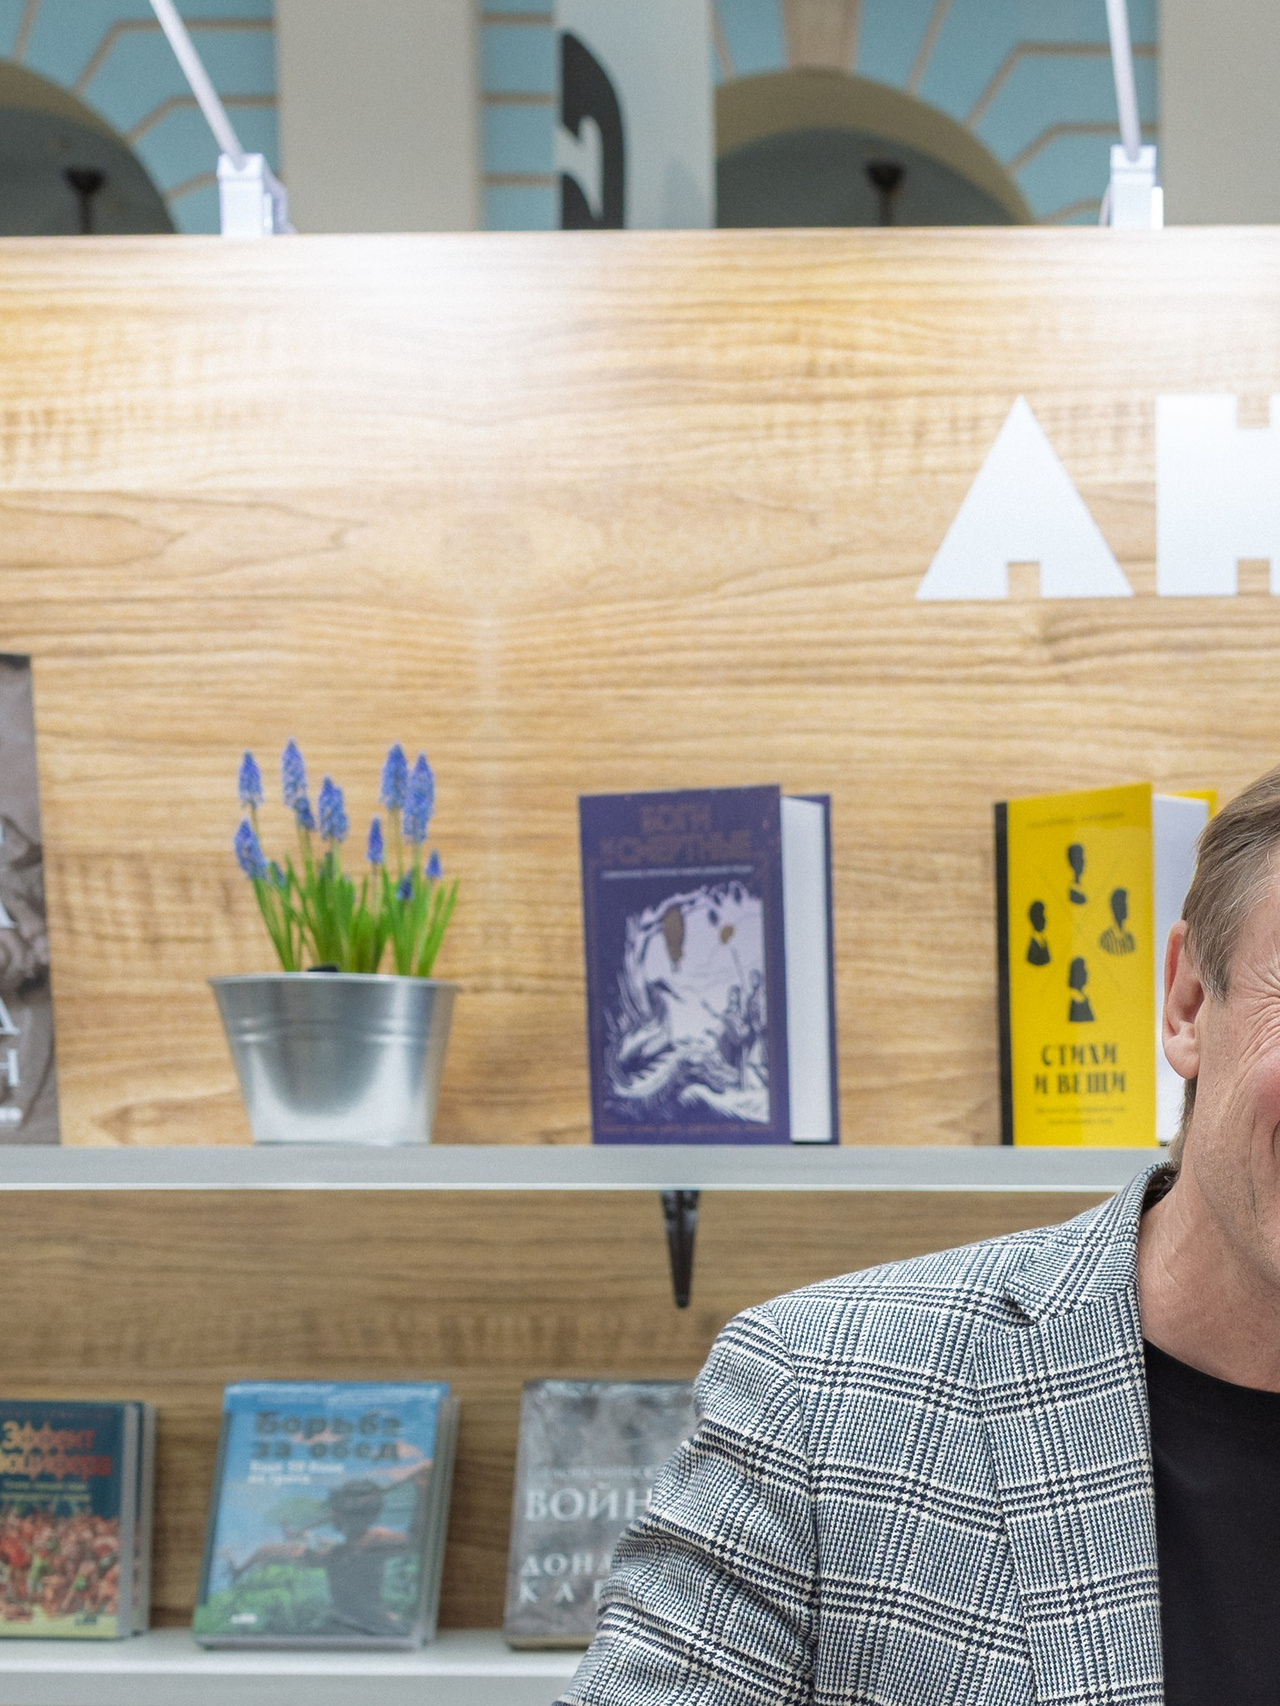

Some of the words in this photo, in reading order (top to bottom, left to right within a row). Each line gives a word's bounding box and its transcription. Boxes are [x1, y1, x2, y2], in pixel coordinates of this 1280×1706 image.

[1041, 1043, 1117, 1066] СТИХИ
[1034, 1073, 1048, 1094] И
[1057, 1070, 1126, 1094] ВЕЩИ
[524, 1481, 653, 1521] ВОЙН
